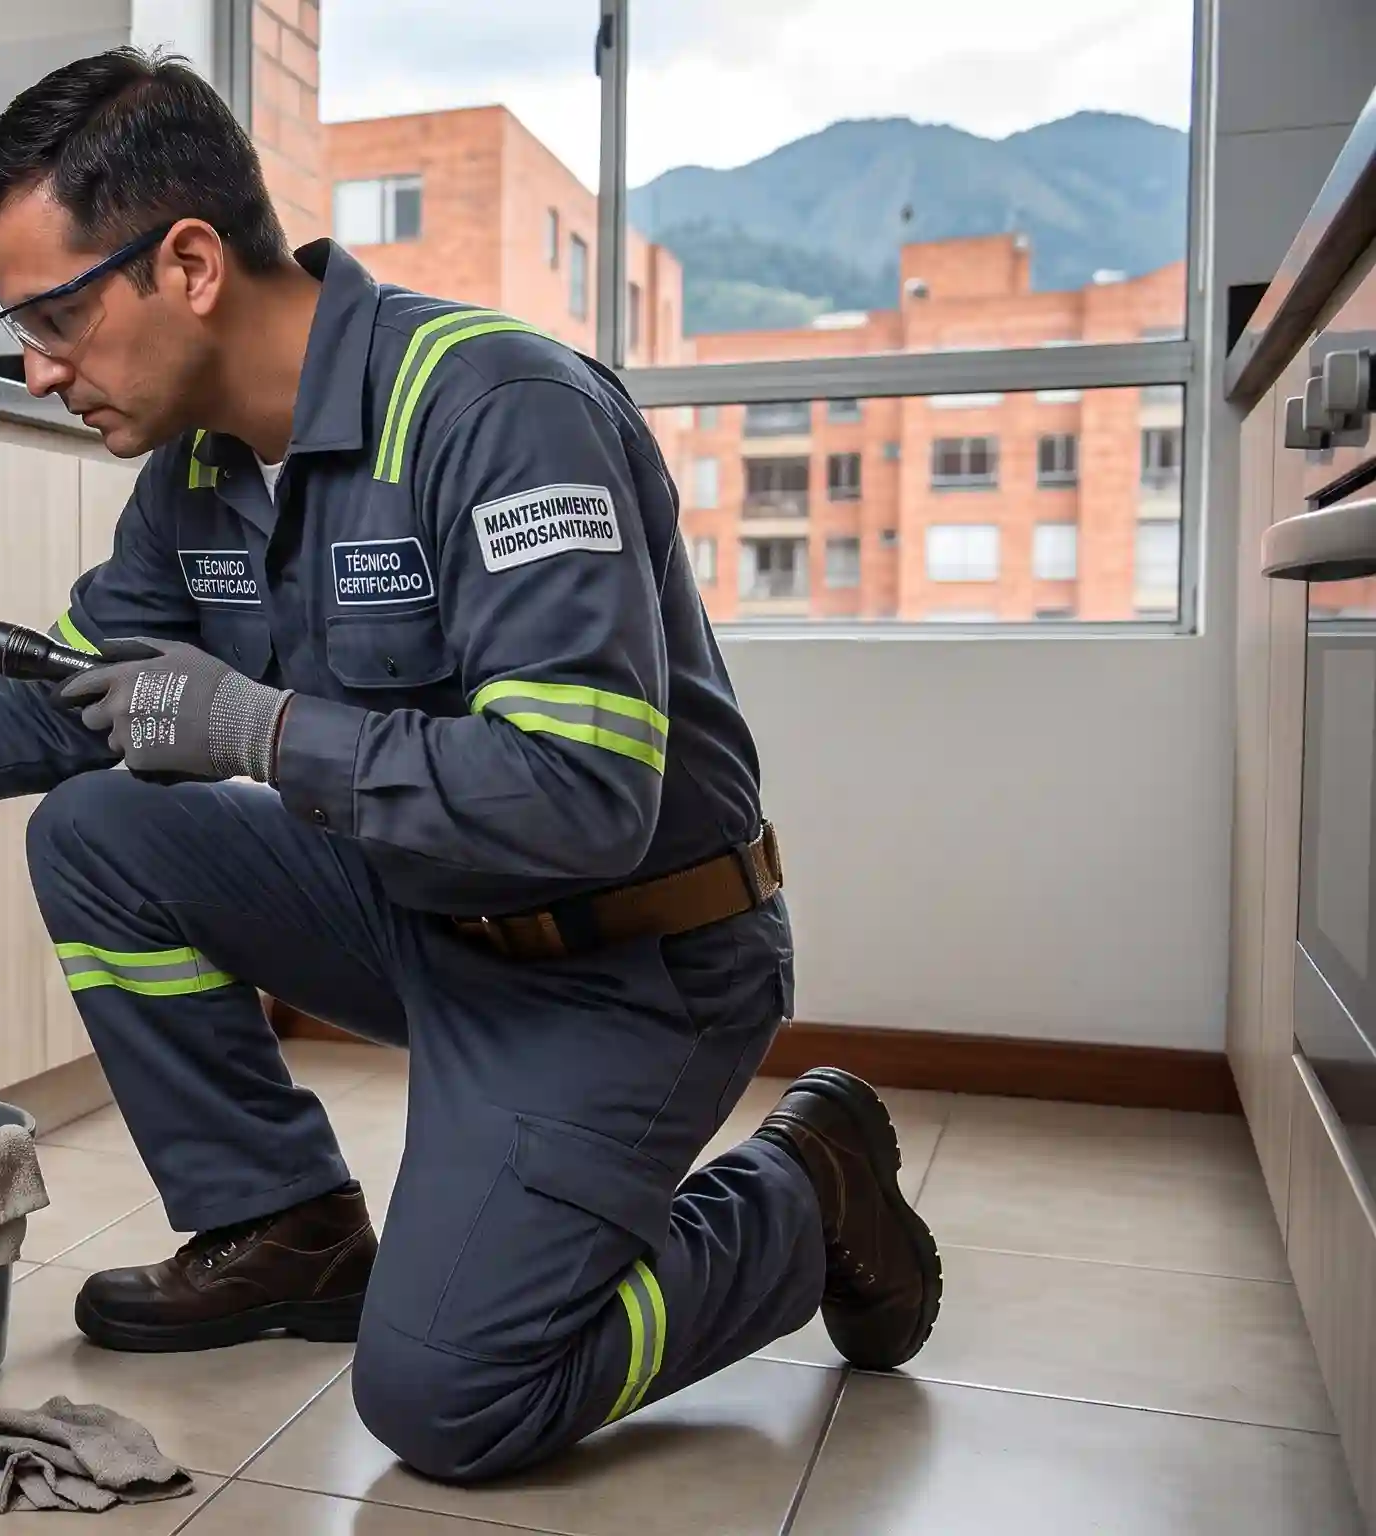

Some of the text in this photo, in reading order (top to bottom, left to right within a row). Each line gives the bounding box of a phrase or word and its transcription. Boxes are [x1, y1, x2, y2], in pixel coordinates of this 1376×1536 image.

[483, 496, 609, 535] MANTENIMIENTO
[489, 519, 614, 559] HIDROSANITARIO
[195, 555, 245, 576] TÉCNICO
[345, 547, 401, 572] TÉCNICO
[339, 573, 423, 594] CERTIFICADO
